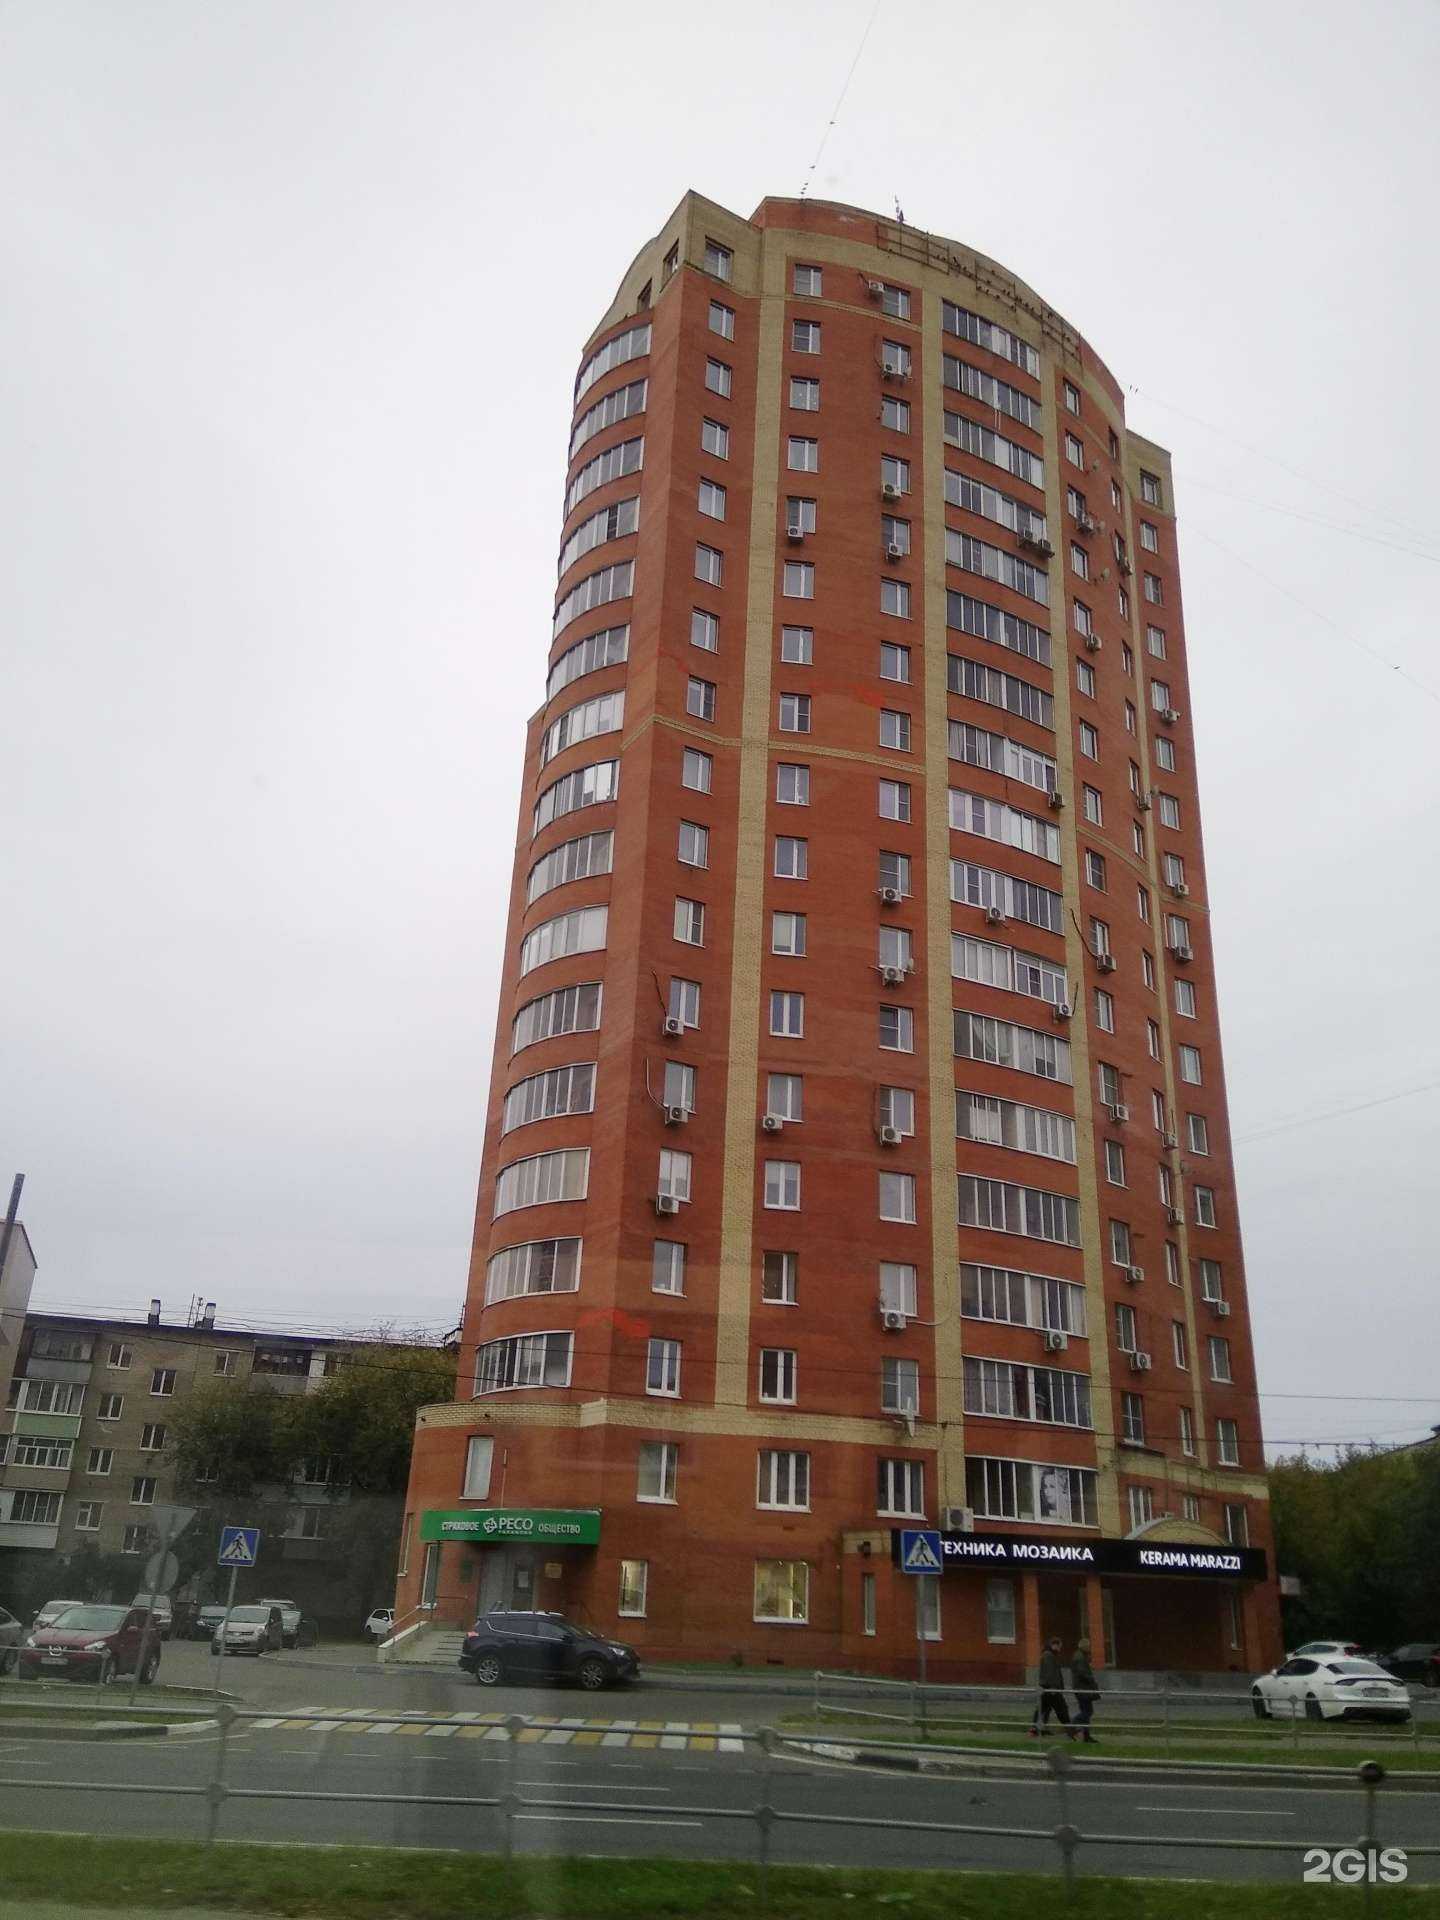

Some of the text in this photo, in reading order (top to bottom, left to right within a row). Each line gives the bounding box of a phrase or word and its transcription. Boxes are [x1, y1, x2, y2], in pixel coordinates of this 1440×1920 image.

[499, 1517, 534, 1530] РЕСО
[538, 1522, 581, 1534] ОБЩЕСТВО
[1012, 1544, 1095, 1561] МОЗАИКА
[1140, 1550, 1241, 1570] KERAMA MARAZZI
